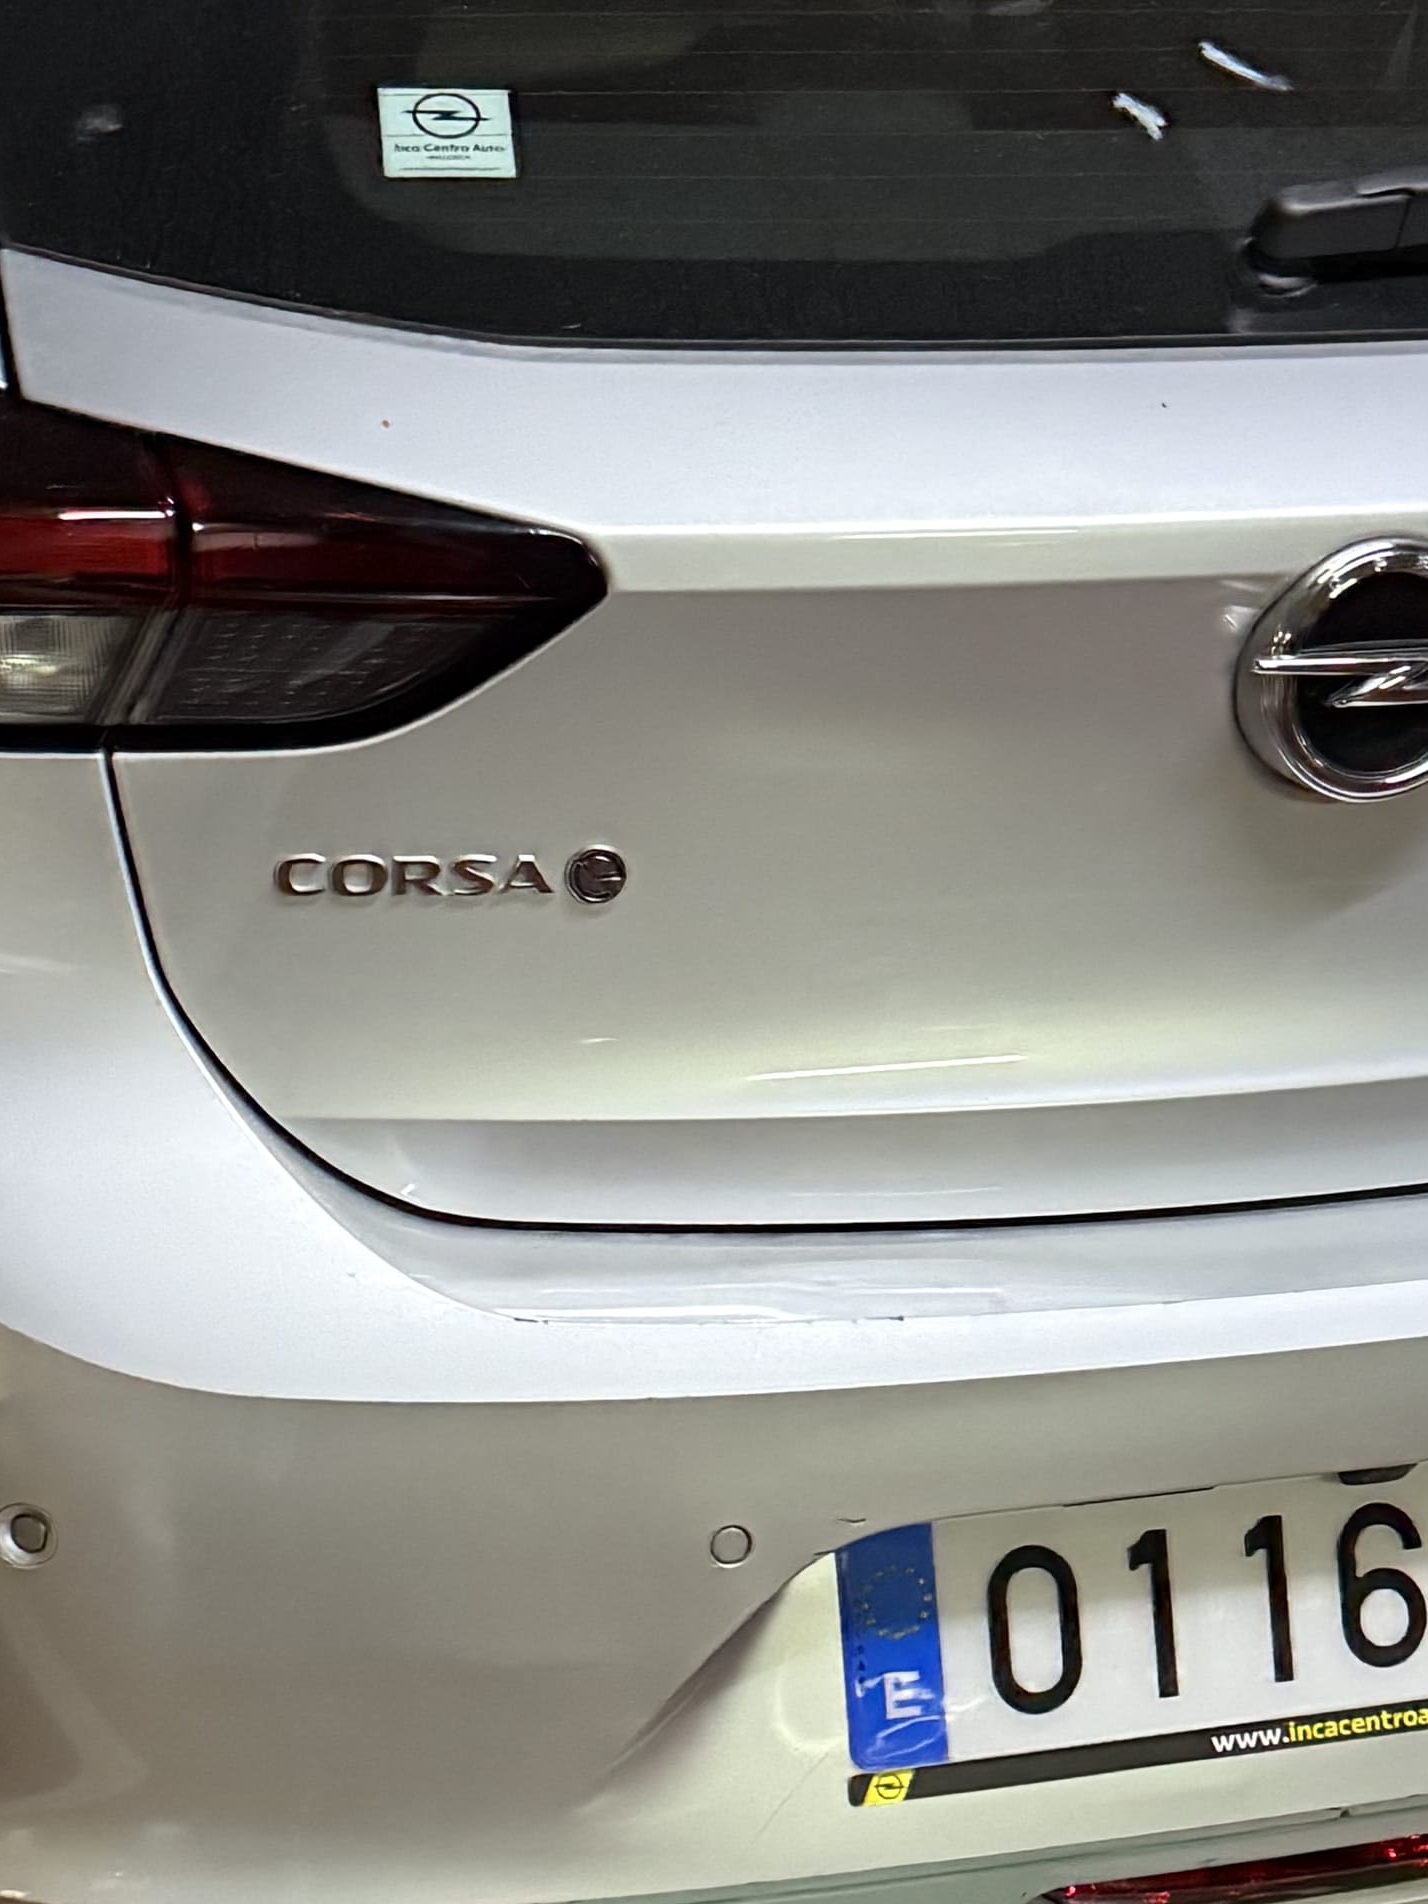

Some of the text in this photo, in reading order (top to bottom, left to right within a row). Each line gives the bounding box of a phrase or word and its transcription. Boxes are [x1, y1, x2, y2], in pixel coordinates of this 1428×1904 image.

[423, 143, 470, 153] Centro
[274, 852, 555, 897] CORSA
[986, 1502, 1428, 1715] 0116
[883, 1670, 923, 1719] E
